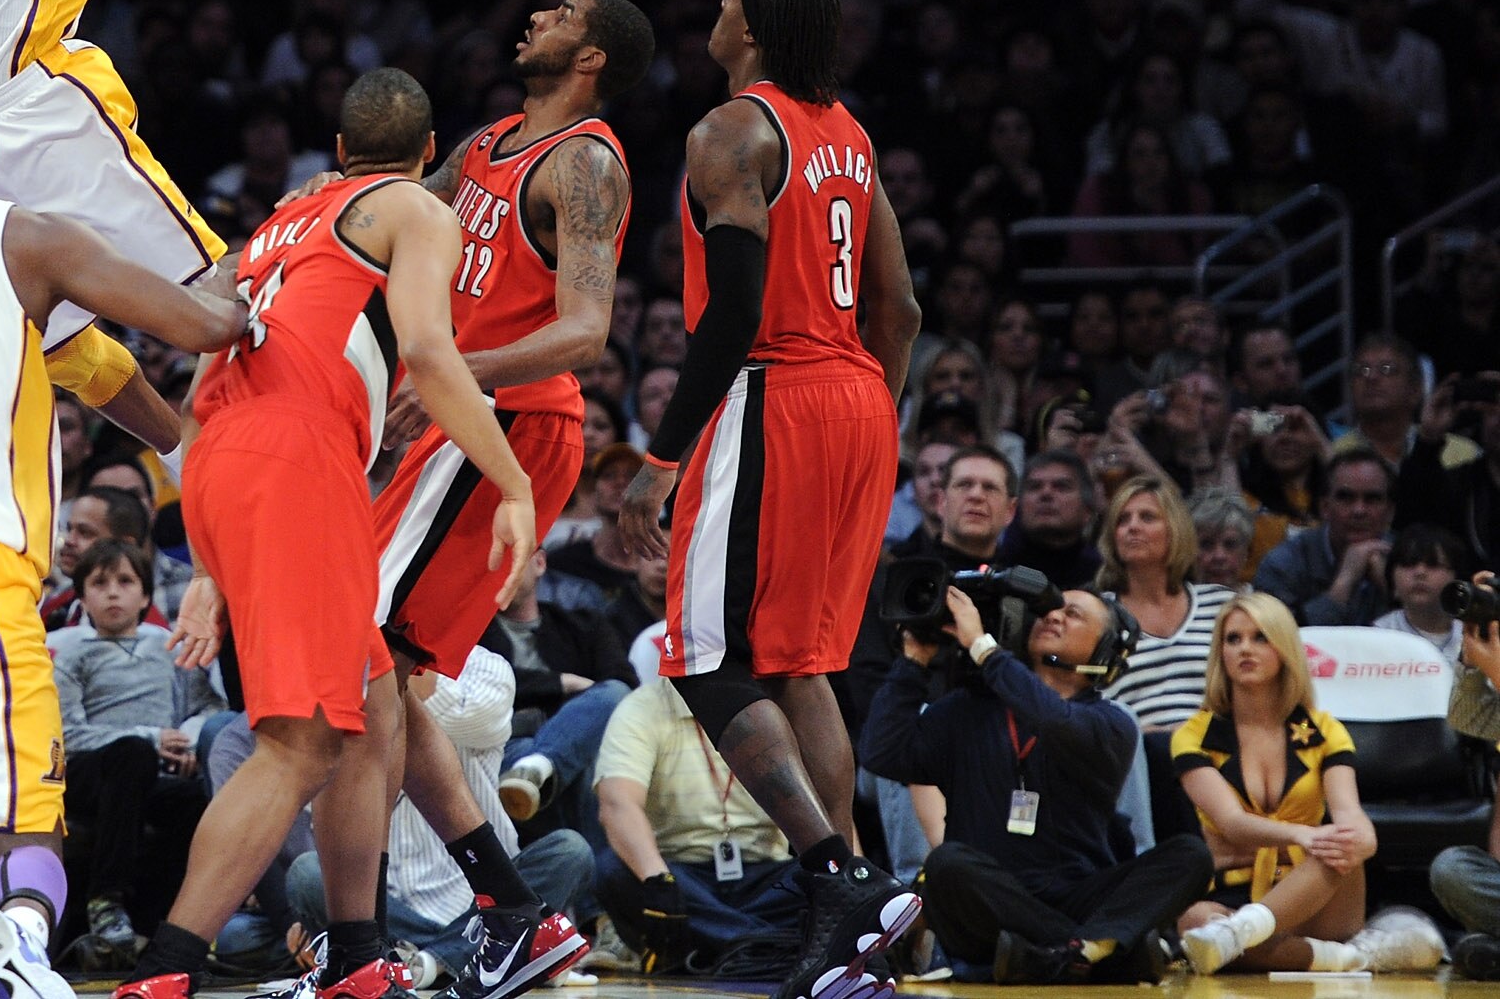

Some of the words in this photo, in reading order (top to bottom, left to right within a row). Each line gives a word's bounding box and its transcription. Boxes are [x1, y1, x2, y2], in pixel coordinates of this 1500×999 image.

[455, 241, 494, 297] 12
[829, 198, 854, 310] 3
[1344, 660, 1441, 678] america
